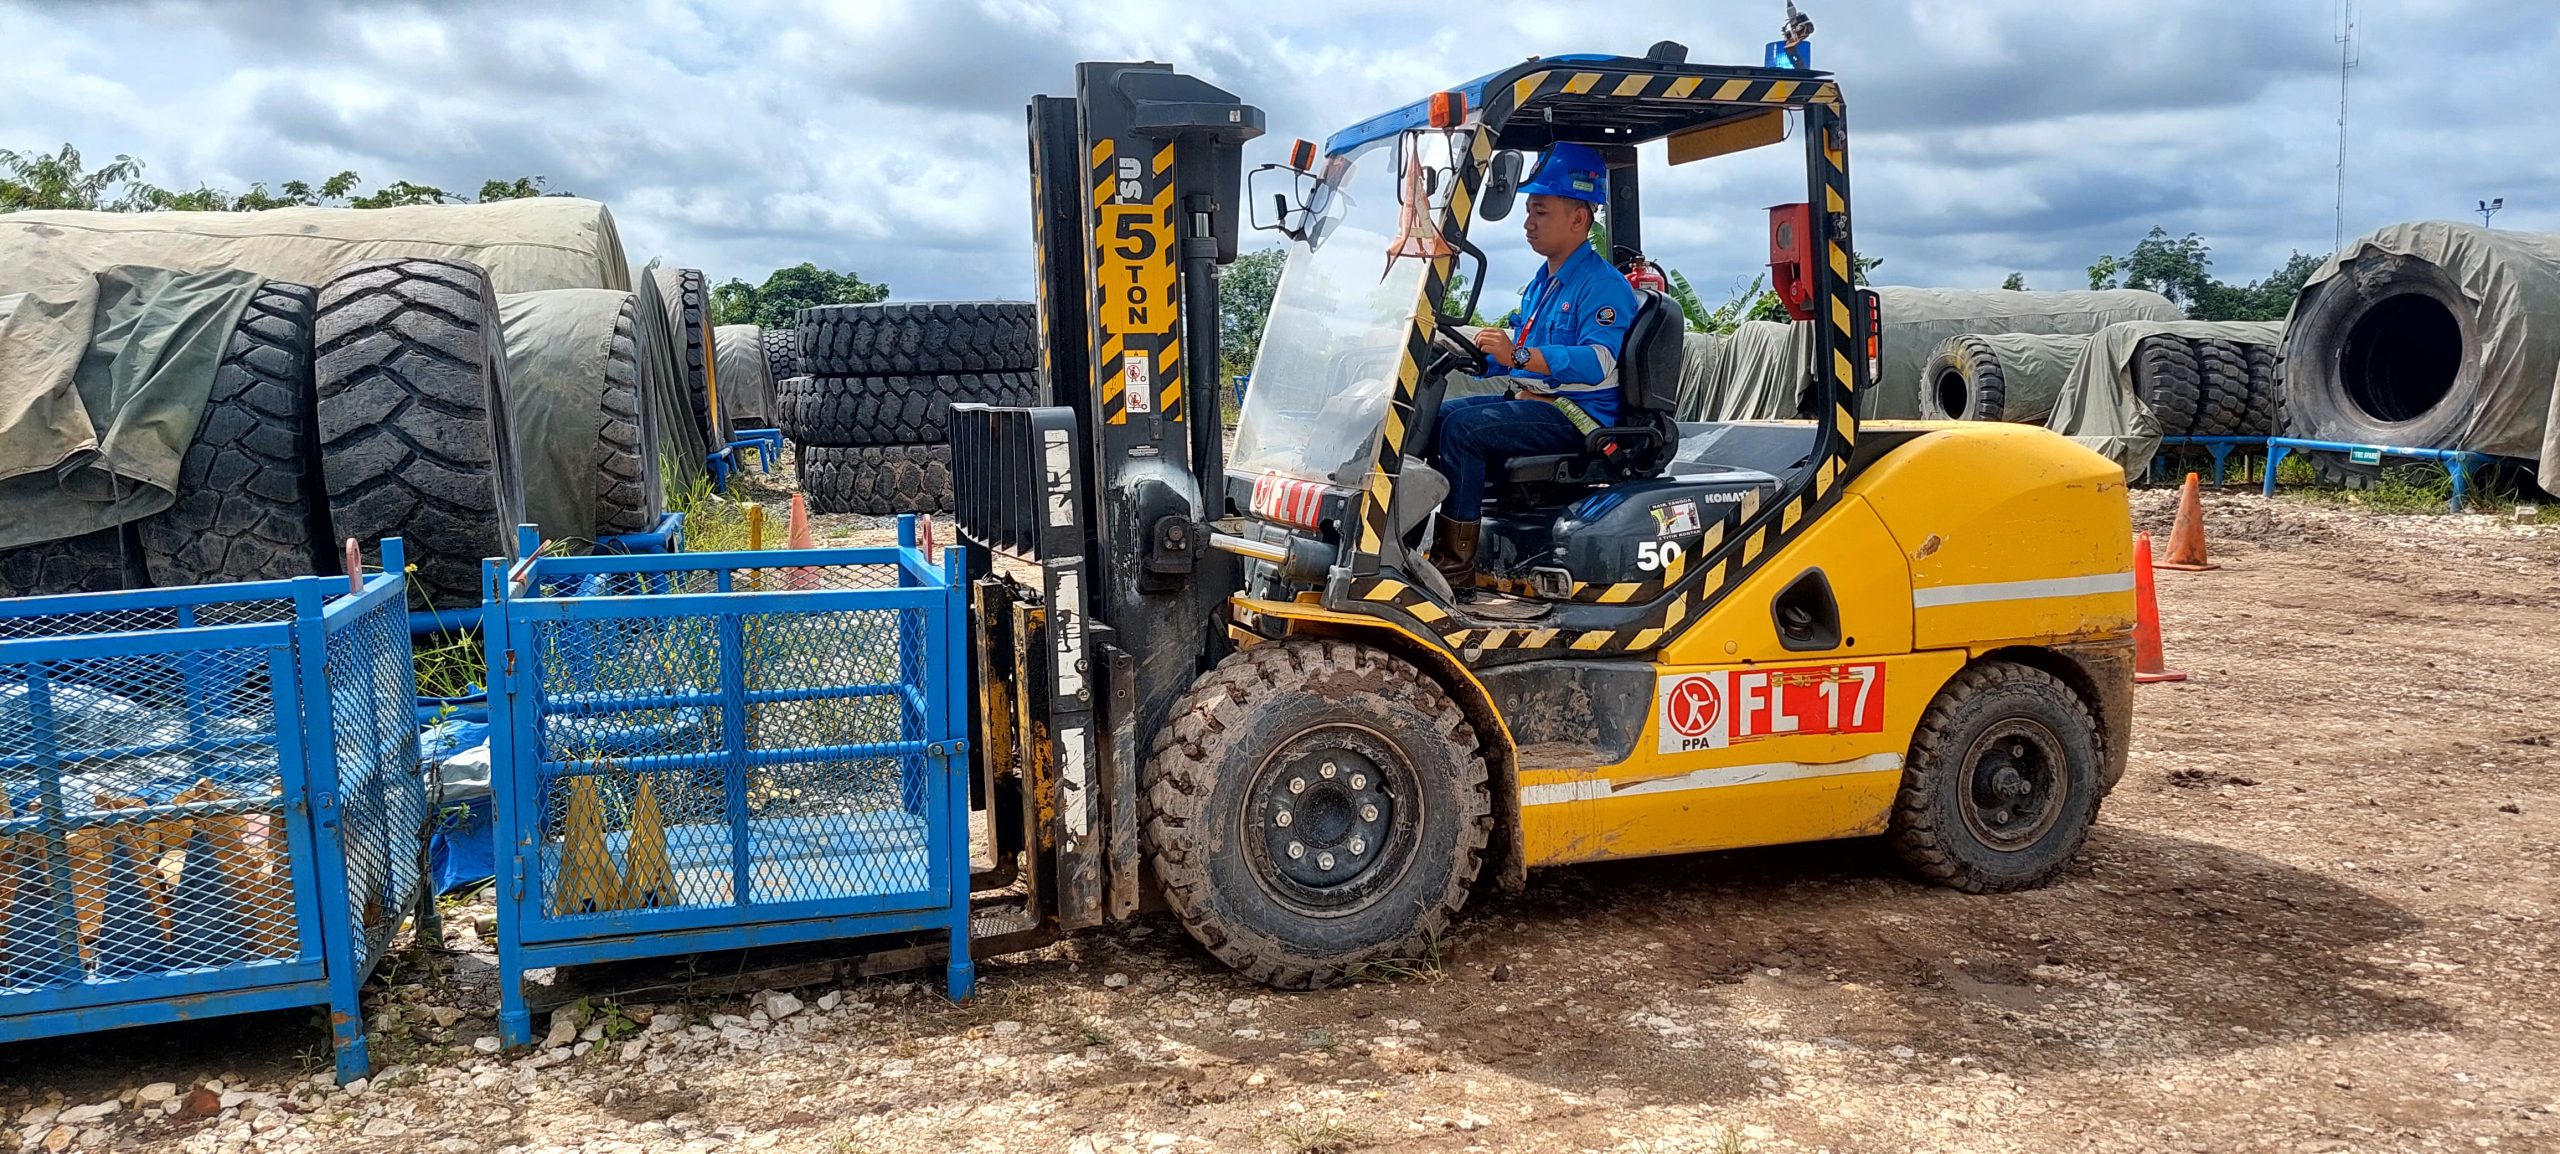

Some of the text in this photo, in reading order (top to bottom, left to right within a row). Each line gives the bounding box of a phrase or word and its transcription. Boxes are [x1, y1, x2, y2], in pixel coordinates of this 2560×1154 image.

[1115, 157, 1143, 204] SU
[1114, 214, 1156, 325] 5 TON
[1268, 477, 1330, 526] FL 17
[1704, 489, 1749, 504] KOMAT
[1637, 541, 1682, 571] 50
[1739, 666, 1876, 736] FL 17
[1681, 737, 1710, 751] PPA
